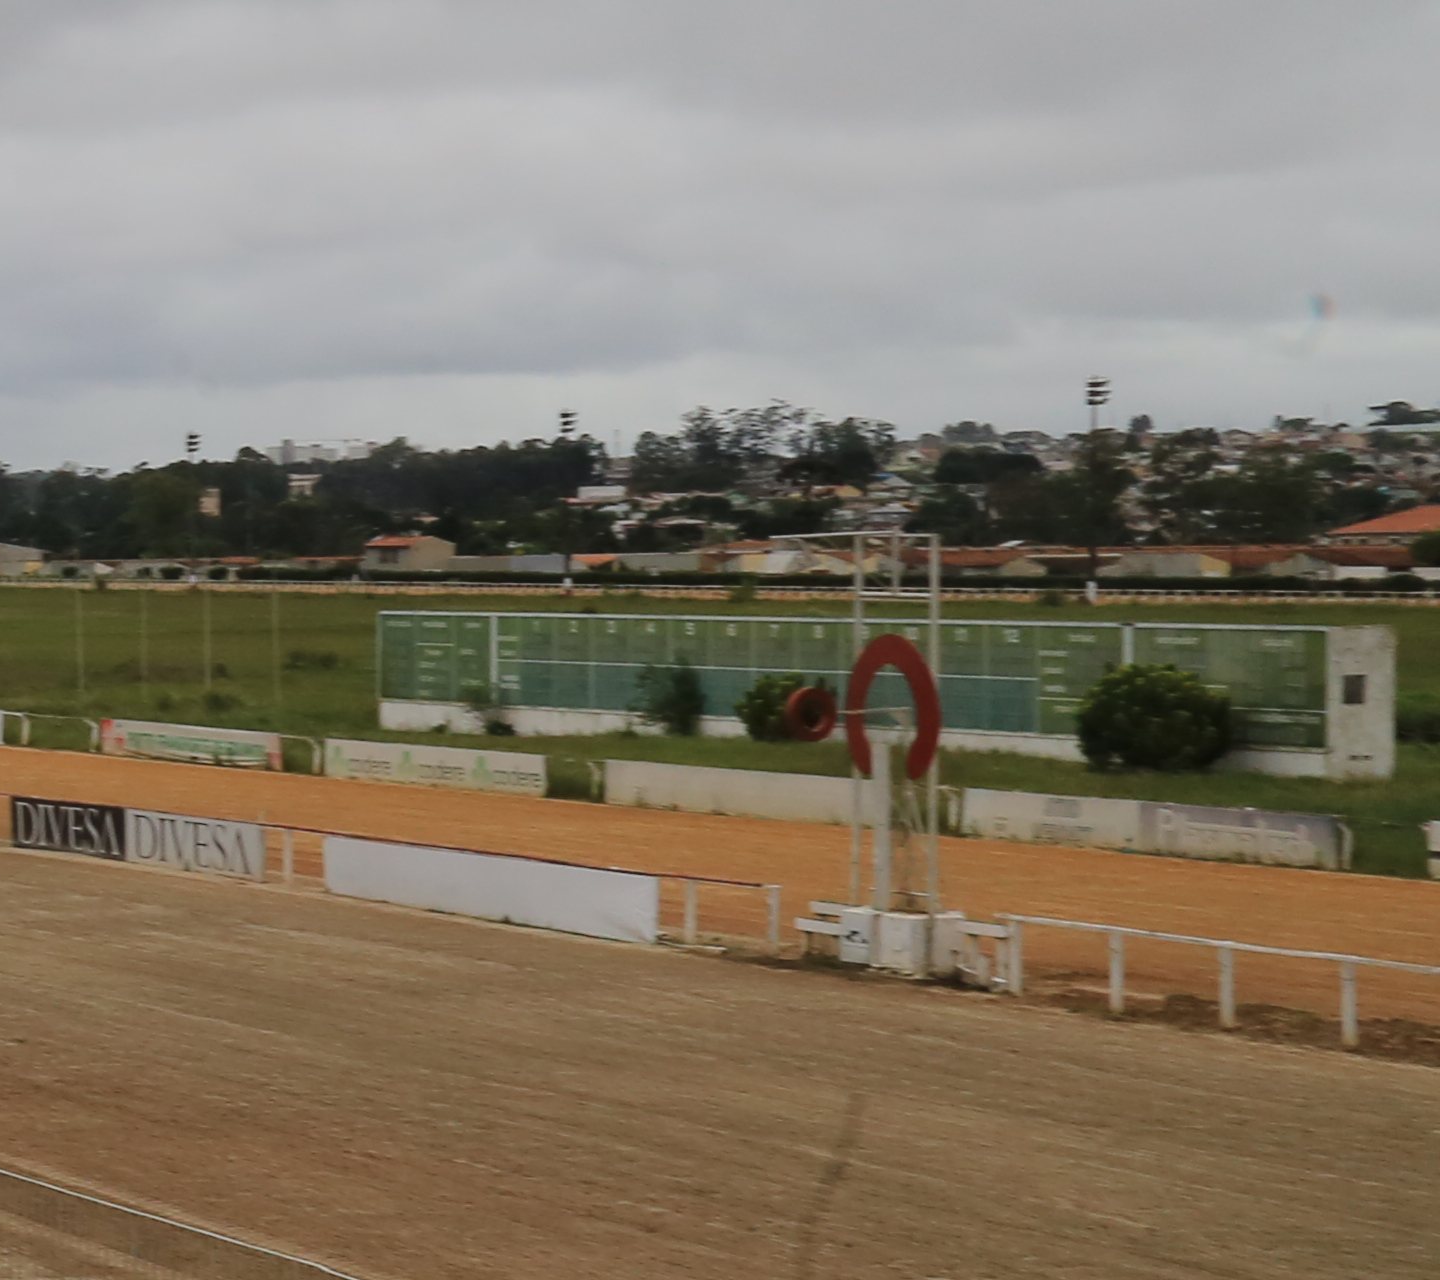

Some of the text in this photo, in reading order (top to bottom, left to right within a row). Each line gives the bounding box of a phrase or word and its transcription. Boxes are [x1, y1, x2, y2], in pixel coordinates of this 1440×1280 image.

[685, 622, 696, 636] 5
[14, 800, 121, 857] DIVESA
[133, 813, 251, 876] DIVESA
